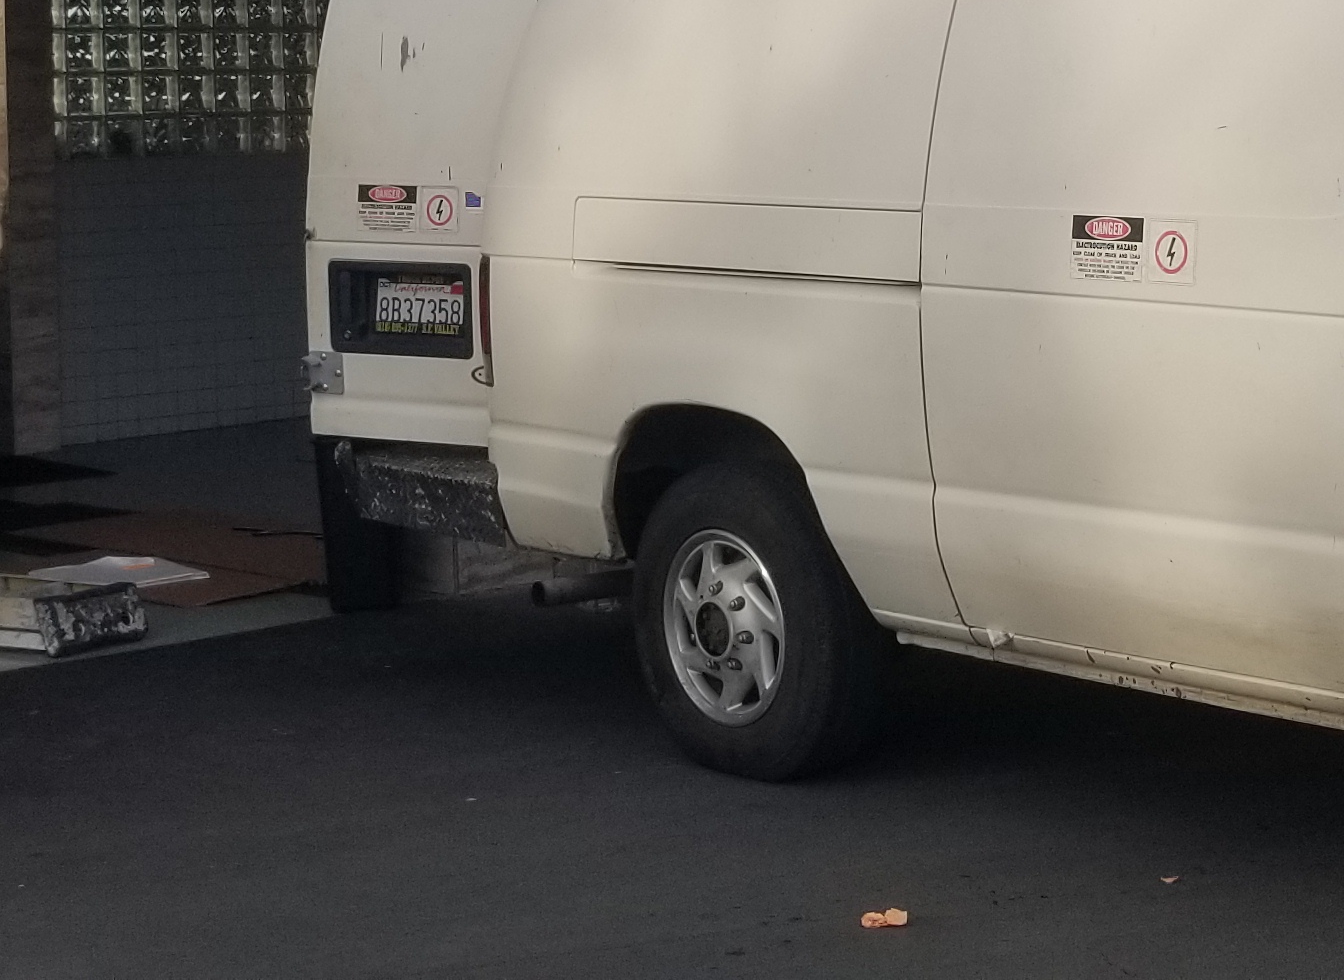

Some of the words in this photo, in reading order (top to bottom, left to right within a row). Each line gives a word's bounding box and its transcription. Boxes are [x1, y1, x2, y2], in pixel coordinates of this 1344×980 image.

[375, 188, 401, 198] DANGER
[1093, 222, 1123, 235] DANGER
[1076, 241, 1115, 250] ELECTROCUTION
[1116, 243, 1138, 251] HAZARD
[394, 283, 449, 296] California
[379, 296, 461, 325] 8B37358
[434, 324, 460, 335] VALLEY
